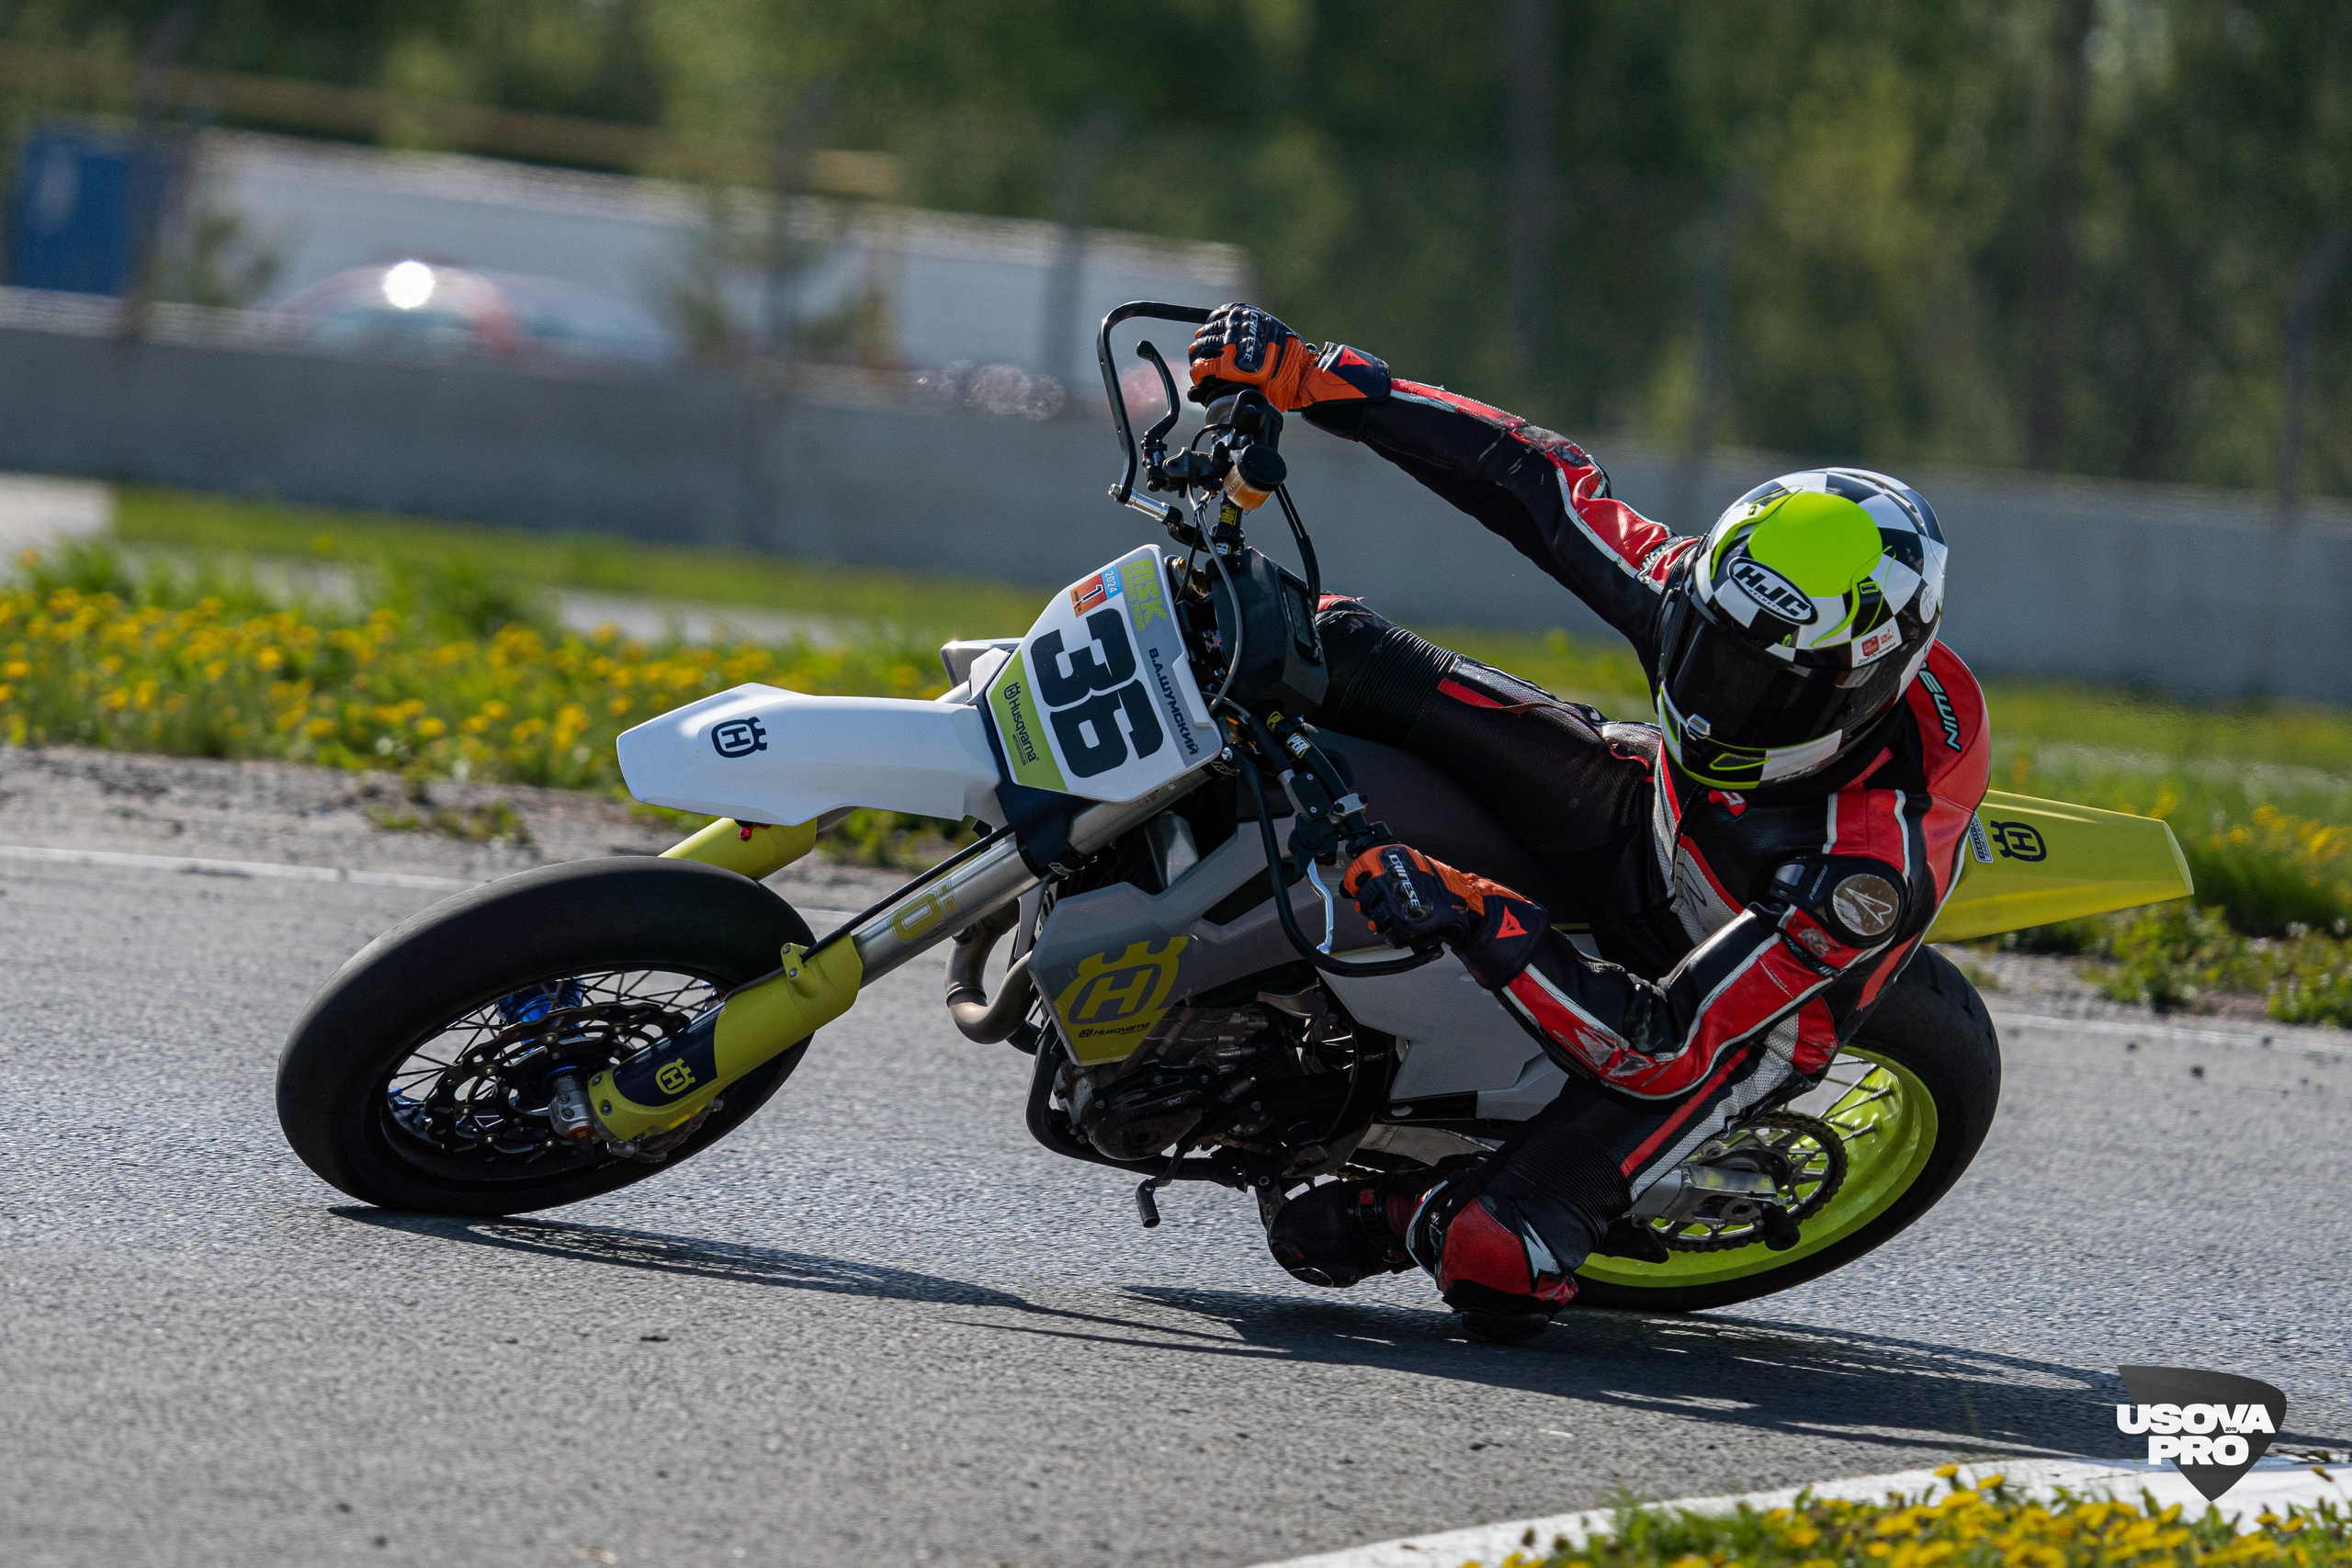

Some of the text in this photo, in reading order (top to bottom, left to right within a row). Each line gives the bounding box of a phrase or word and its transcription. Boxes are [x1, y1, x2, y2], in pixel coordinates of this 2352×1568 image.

[1081, 584, 1104, 603] 1
[1104, 570, 1118, 593] 2024
[1131, 557, 1168, 626] MSK
[1734, 564, 1810, 617] HJC
[1748, 589, 1781, 611] HELMETS
[1030, 607, 1165, 779] 36
[1148, 648, 1200, 755] В.А.ШУМСКИЙ
[1916, 661, 1962, 751] EWIN
[1009, 697, 1037, 762] Husqvarna
[1012, 733, 1027, 766] MOTORCYCLES
[1388, 854, 1421, 908] DAINESE
[1093, 1022, 1150, 1036] Husqvarna
